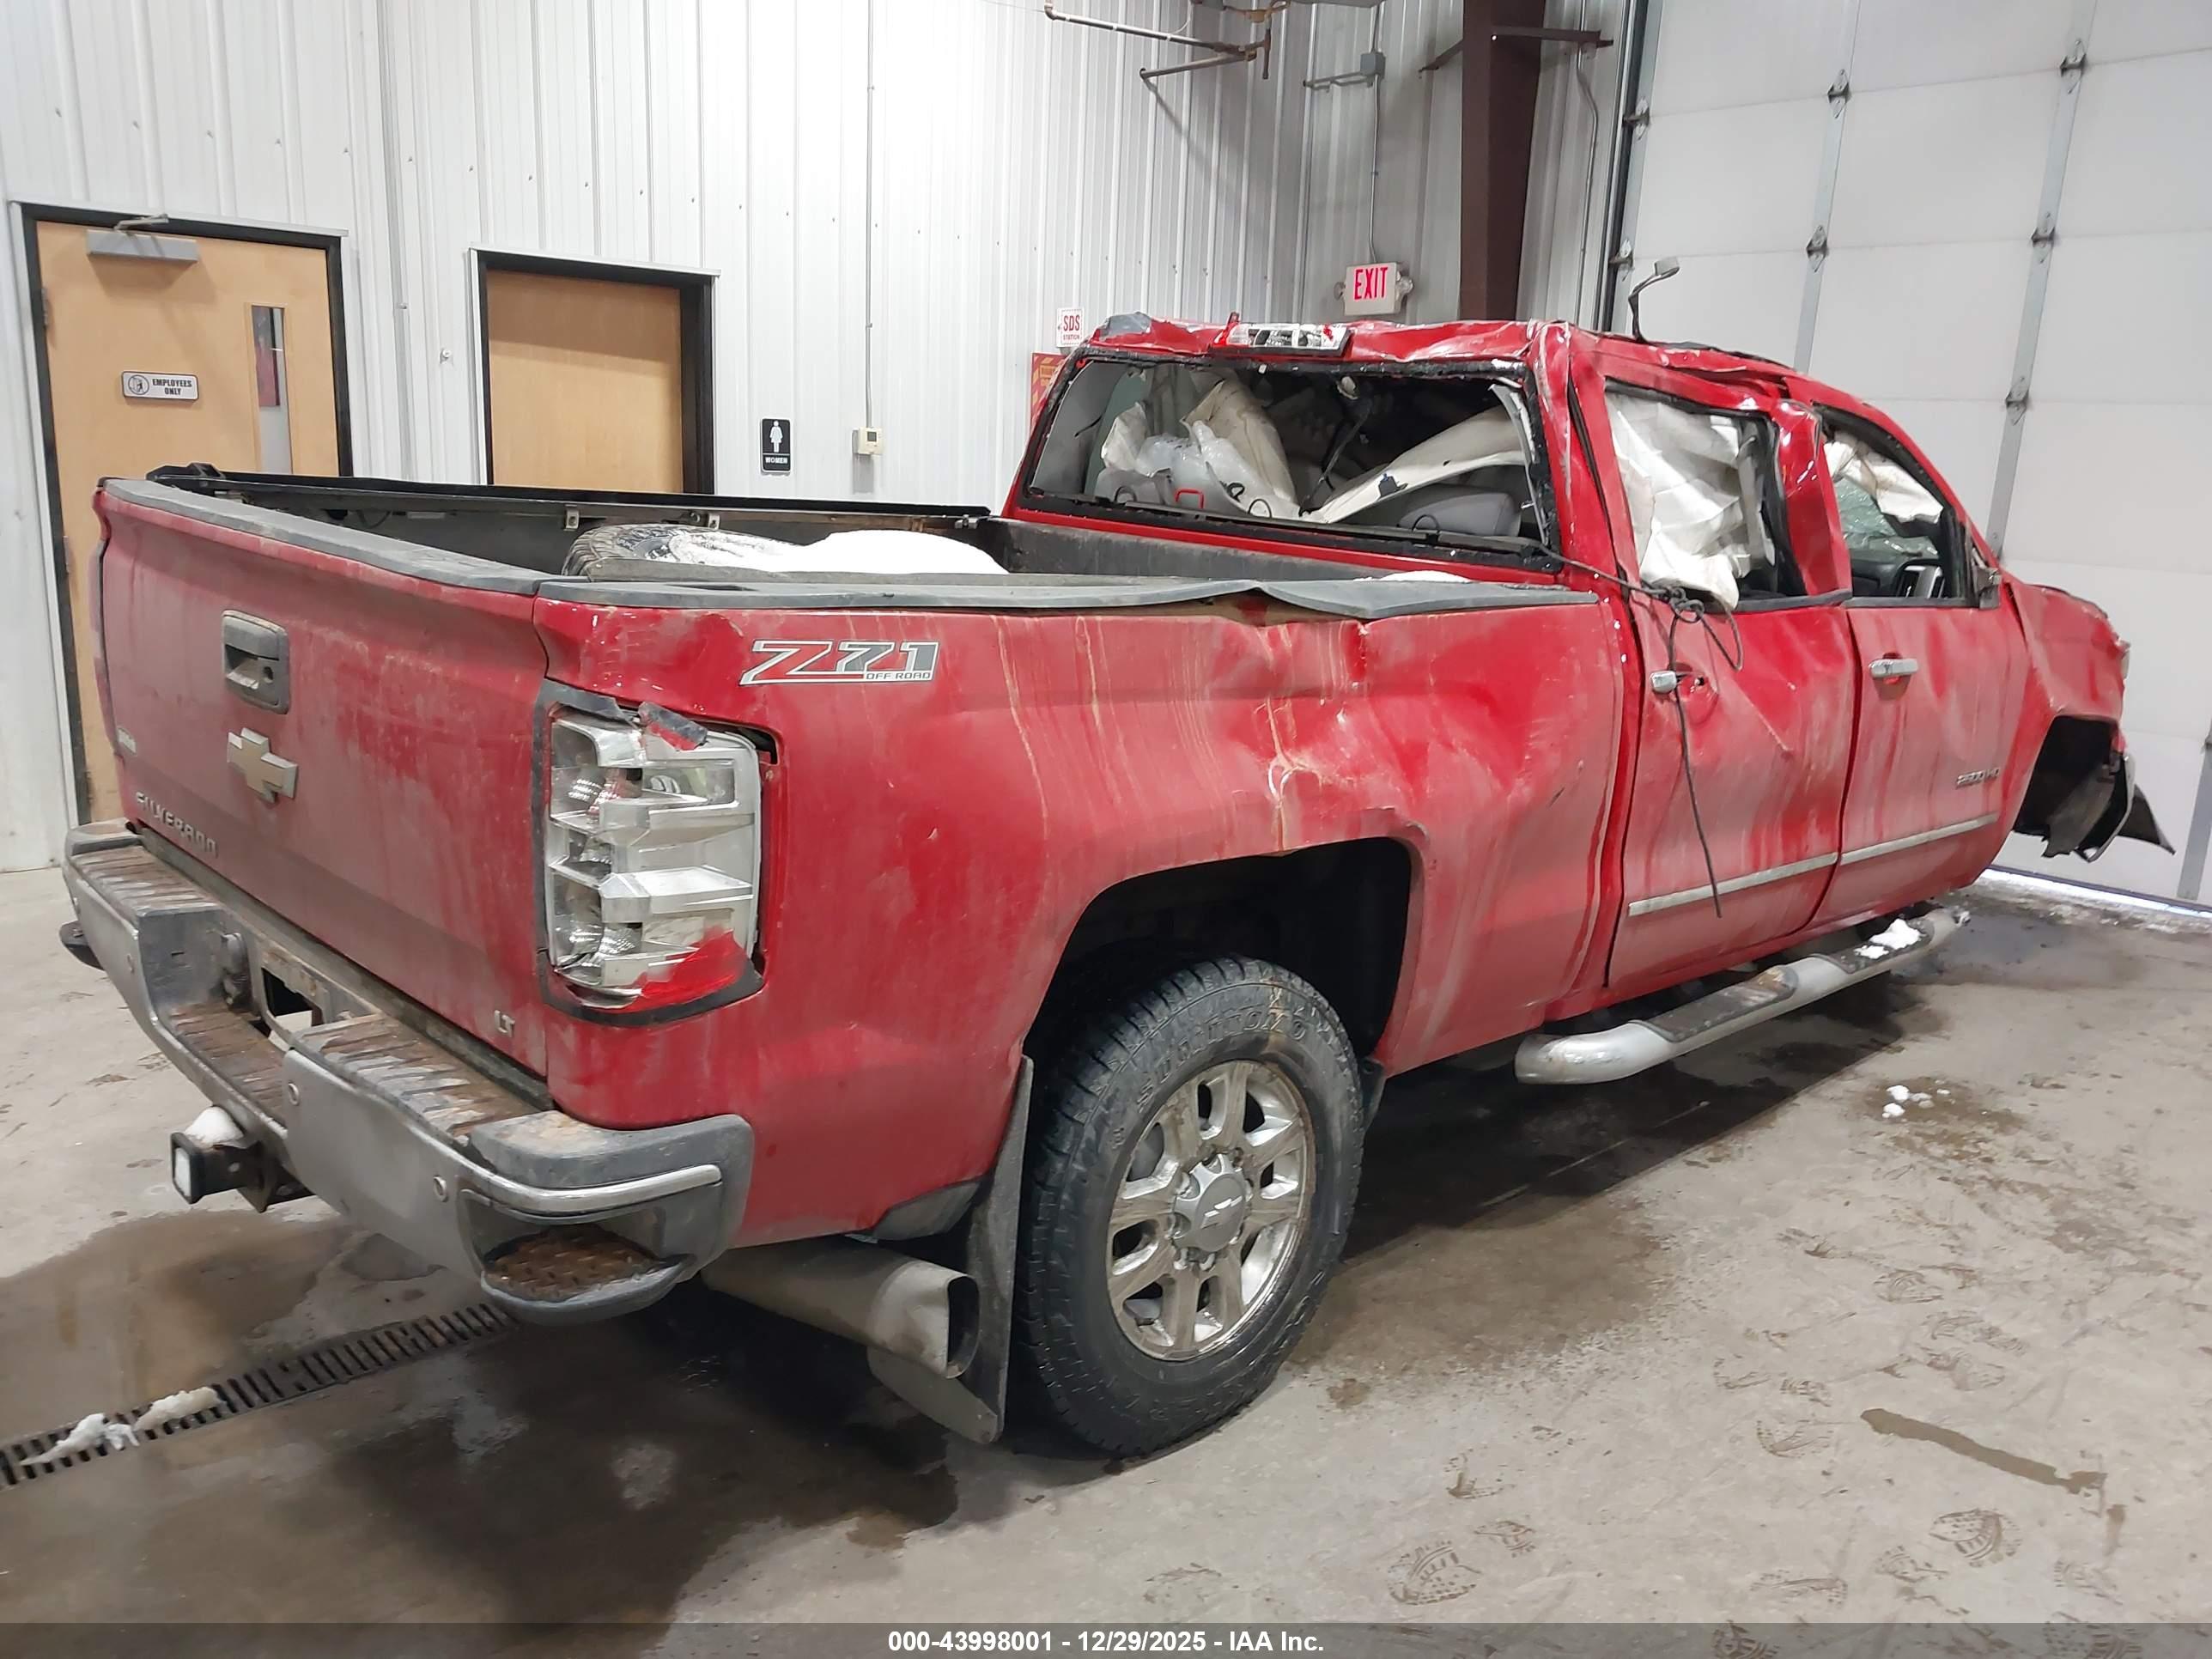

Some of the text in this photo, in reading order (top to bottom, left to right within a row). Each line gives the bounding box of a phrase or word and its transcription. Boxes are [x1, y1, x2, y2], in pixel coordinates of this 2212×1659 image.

[1354, 266, 1389, 300] EXIT
[1063, 314, 1080, 331] SDS
[152, 379, 192, 387] EMPLOYEES
[738, 640, 939, 686] Z71
[895, 672, 931, 680] ROAD
[136, 792, 218, 855] SILVERADO
[494, 1010, 515, 1037] LT
